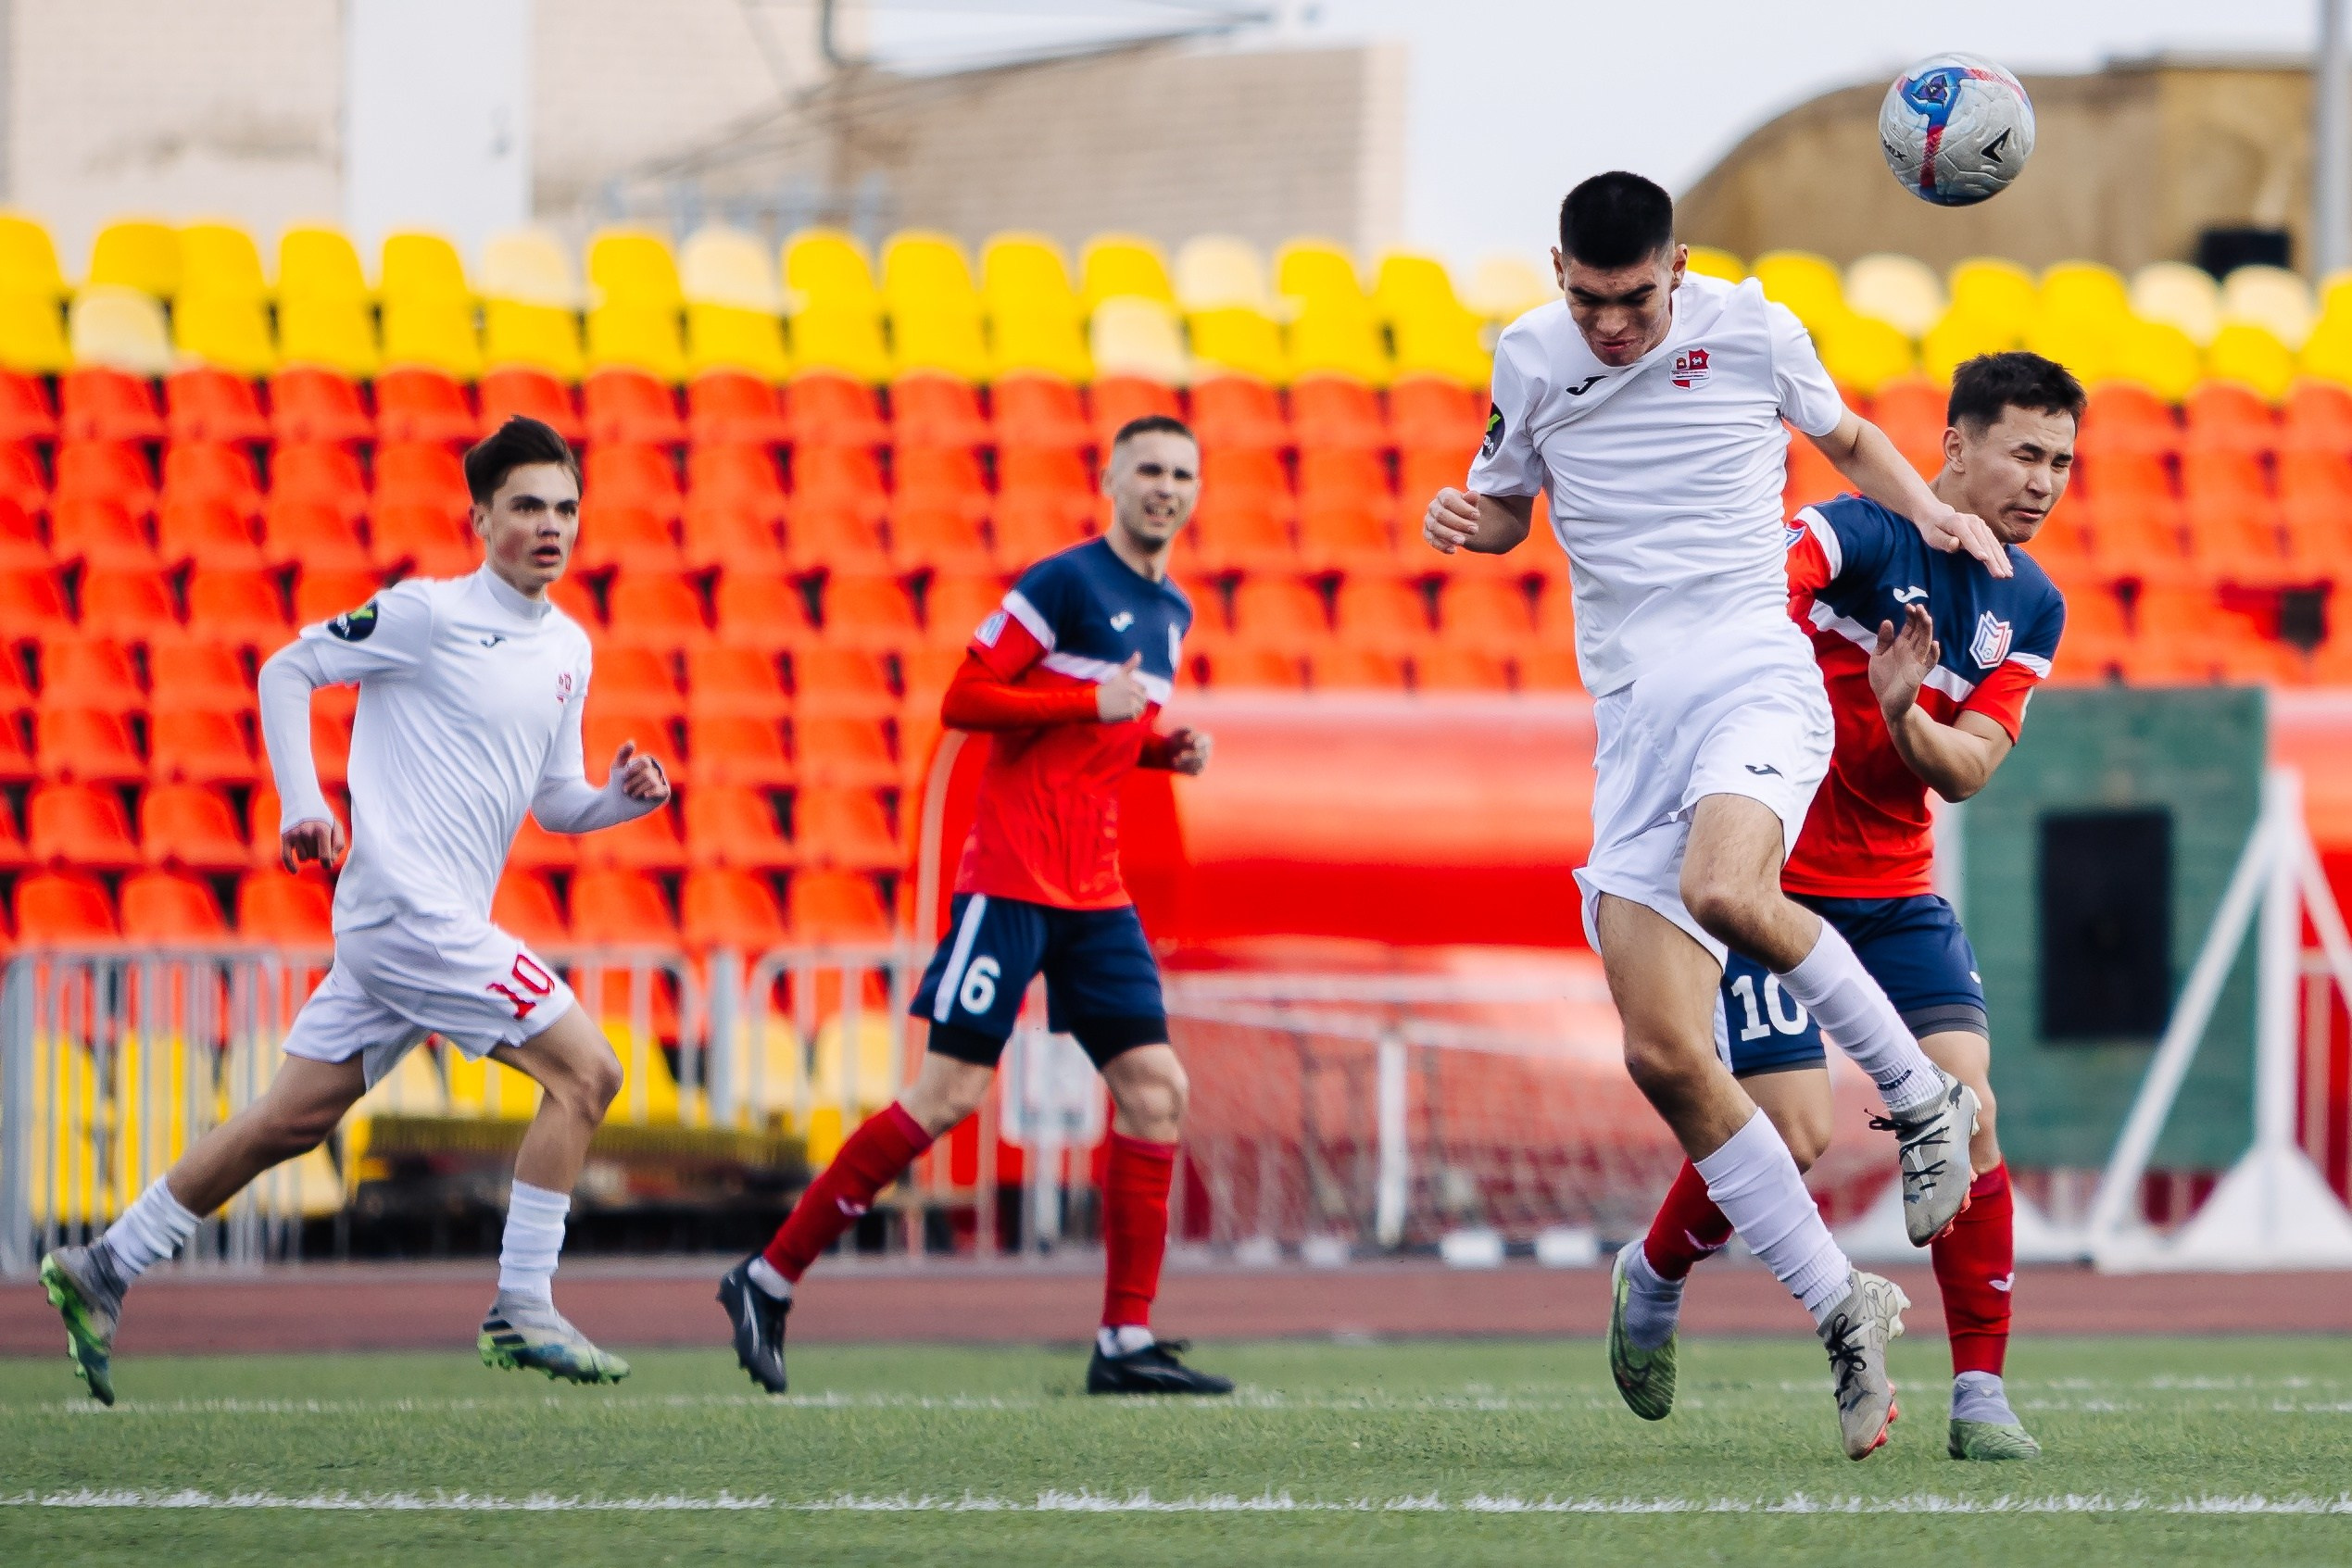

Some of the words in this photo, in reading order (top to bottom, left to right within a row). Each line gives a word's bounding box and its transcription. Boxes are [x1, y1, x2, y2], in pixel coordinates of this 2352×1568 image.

[485, 953, 555, 1021] 10
[960, 955, 1001, 1015] 6
[1730, 972, 1809, 1042] 10
